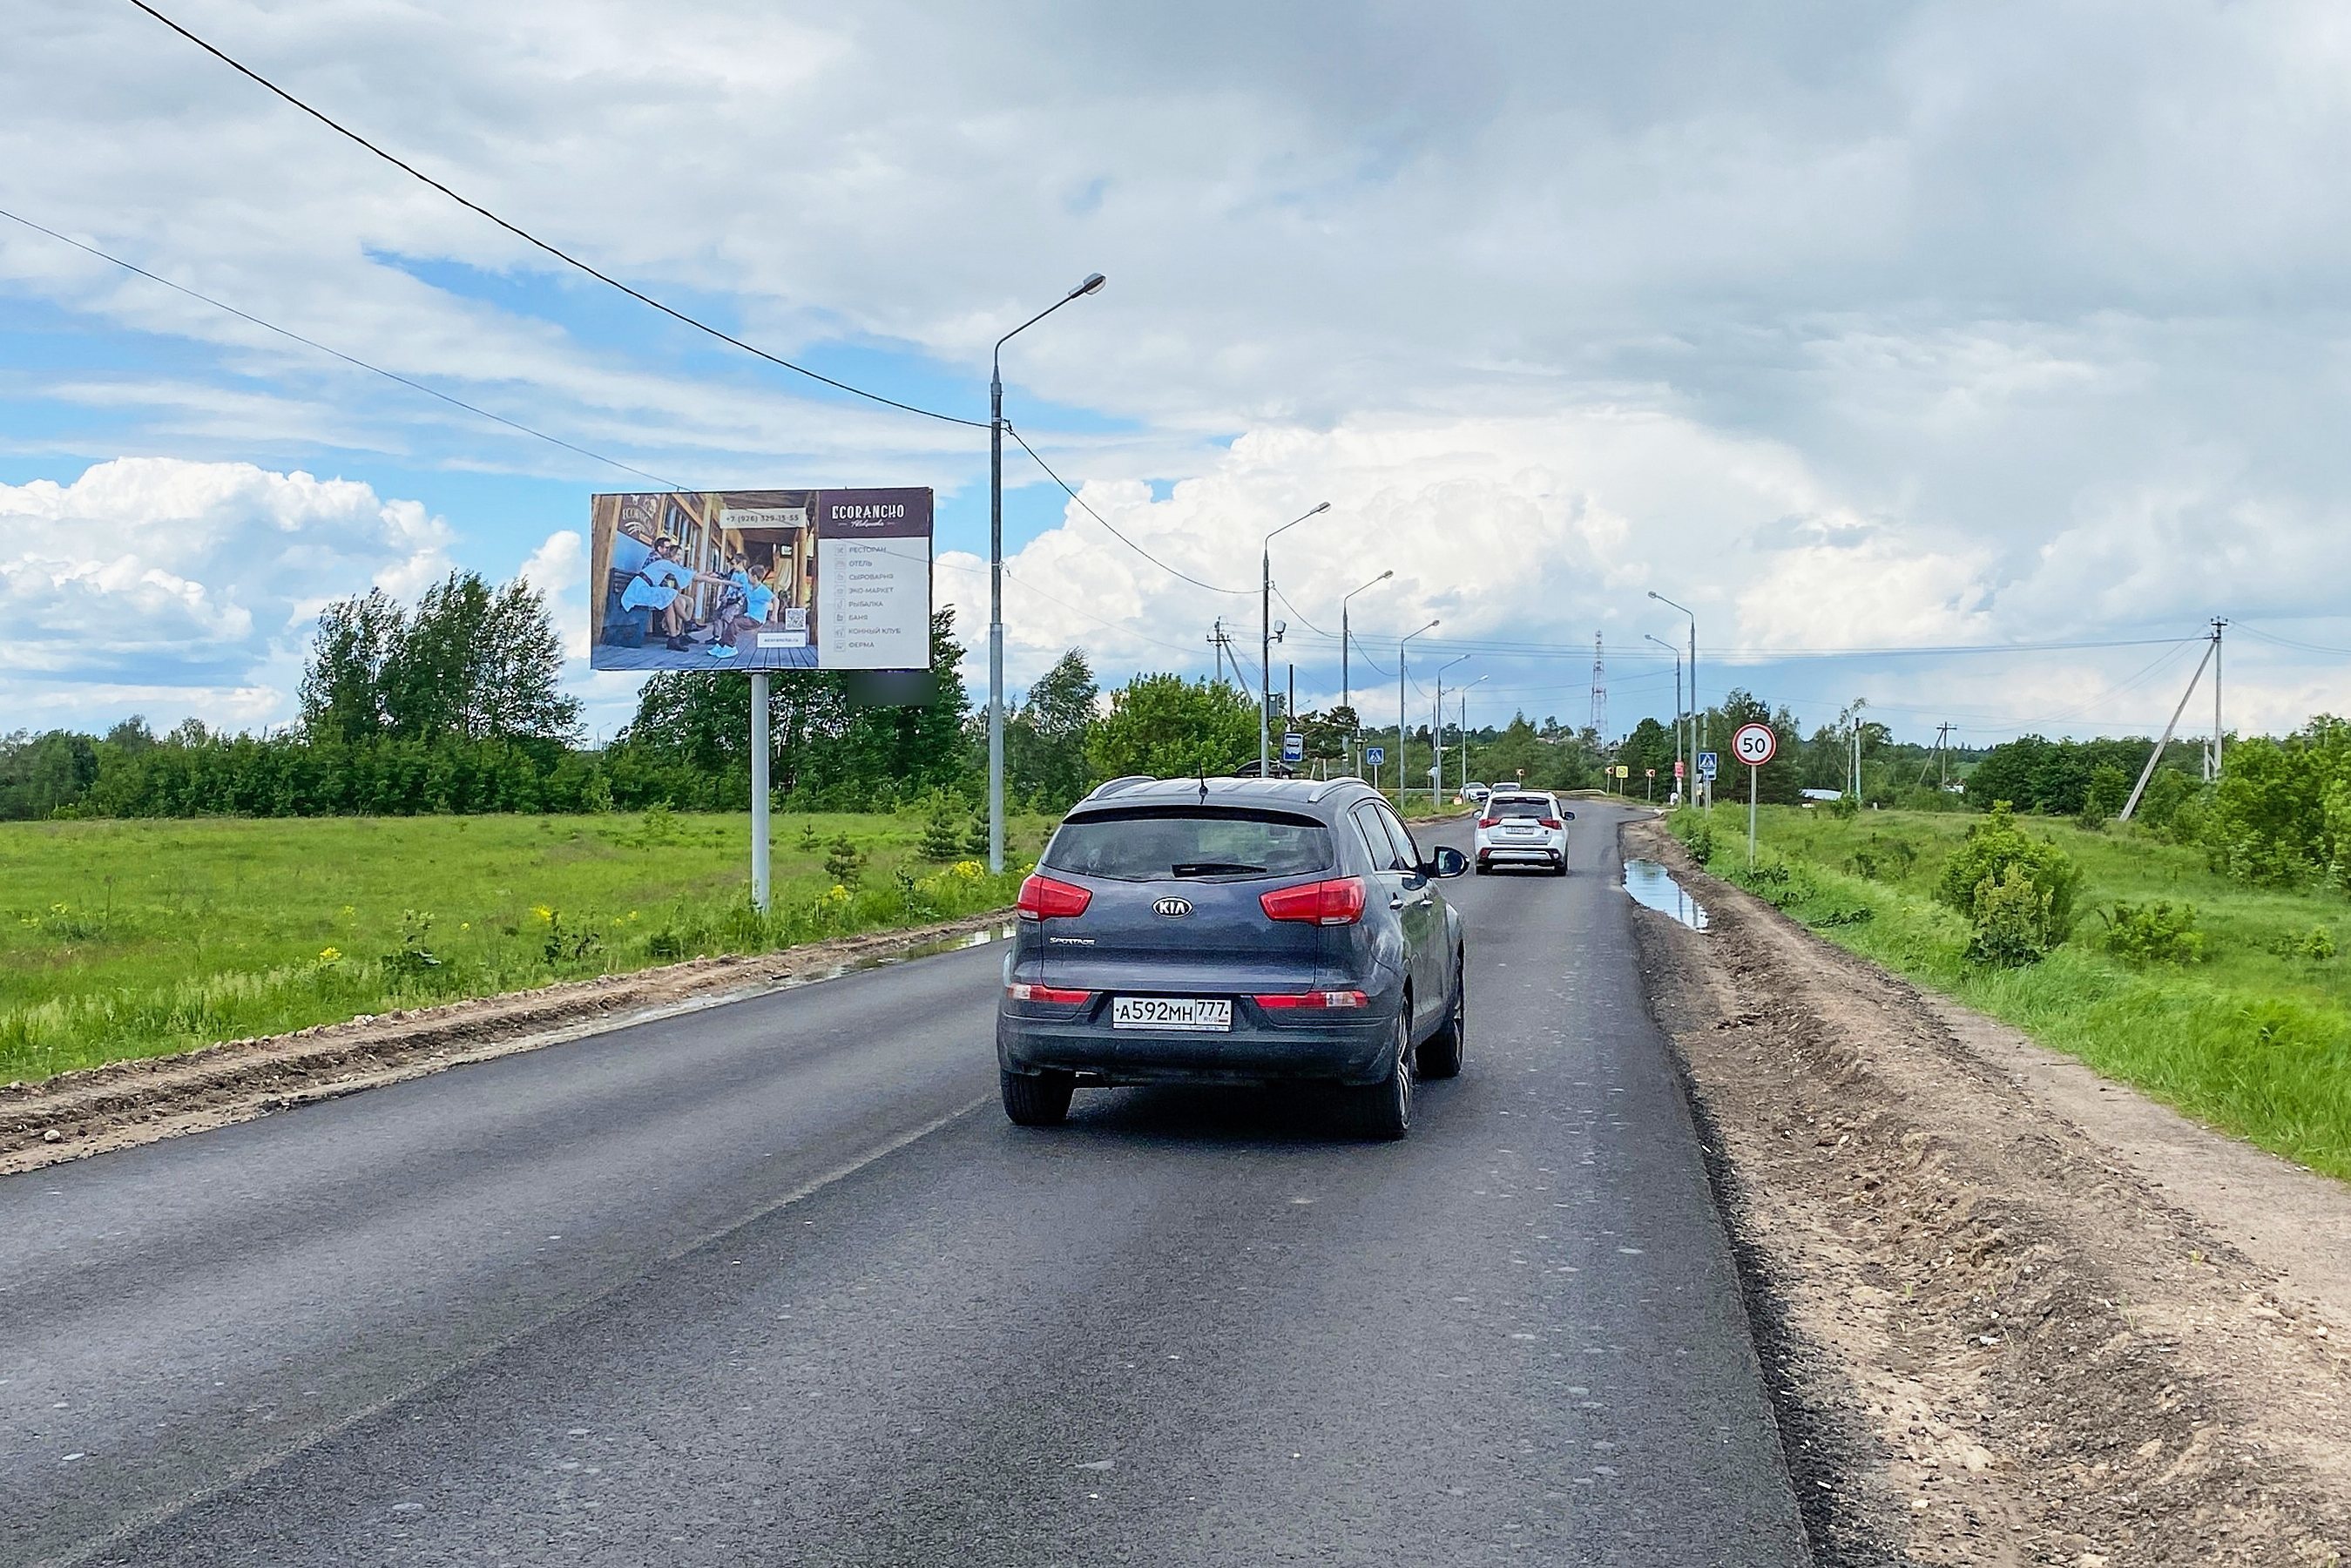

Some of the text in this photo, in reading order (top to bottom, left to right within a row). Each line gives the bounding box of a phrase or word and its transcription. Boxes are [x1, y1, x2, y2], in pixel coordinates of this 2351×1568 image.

[832, 504, 904, 519] ECORANCHO
[1743, 738, 1766, 754] 50
[1159, 902, 1186, 914] KIA
[1197, 1002, 1226, 1017] 777
